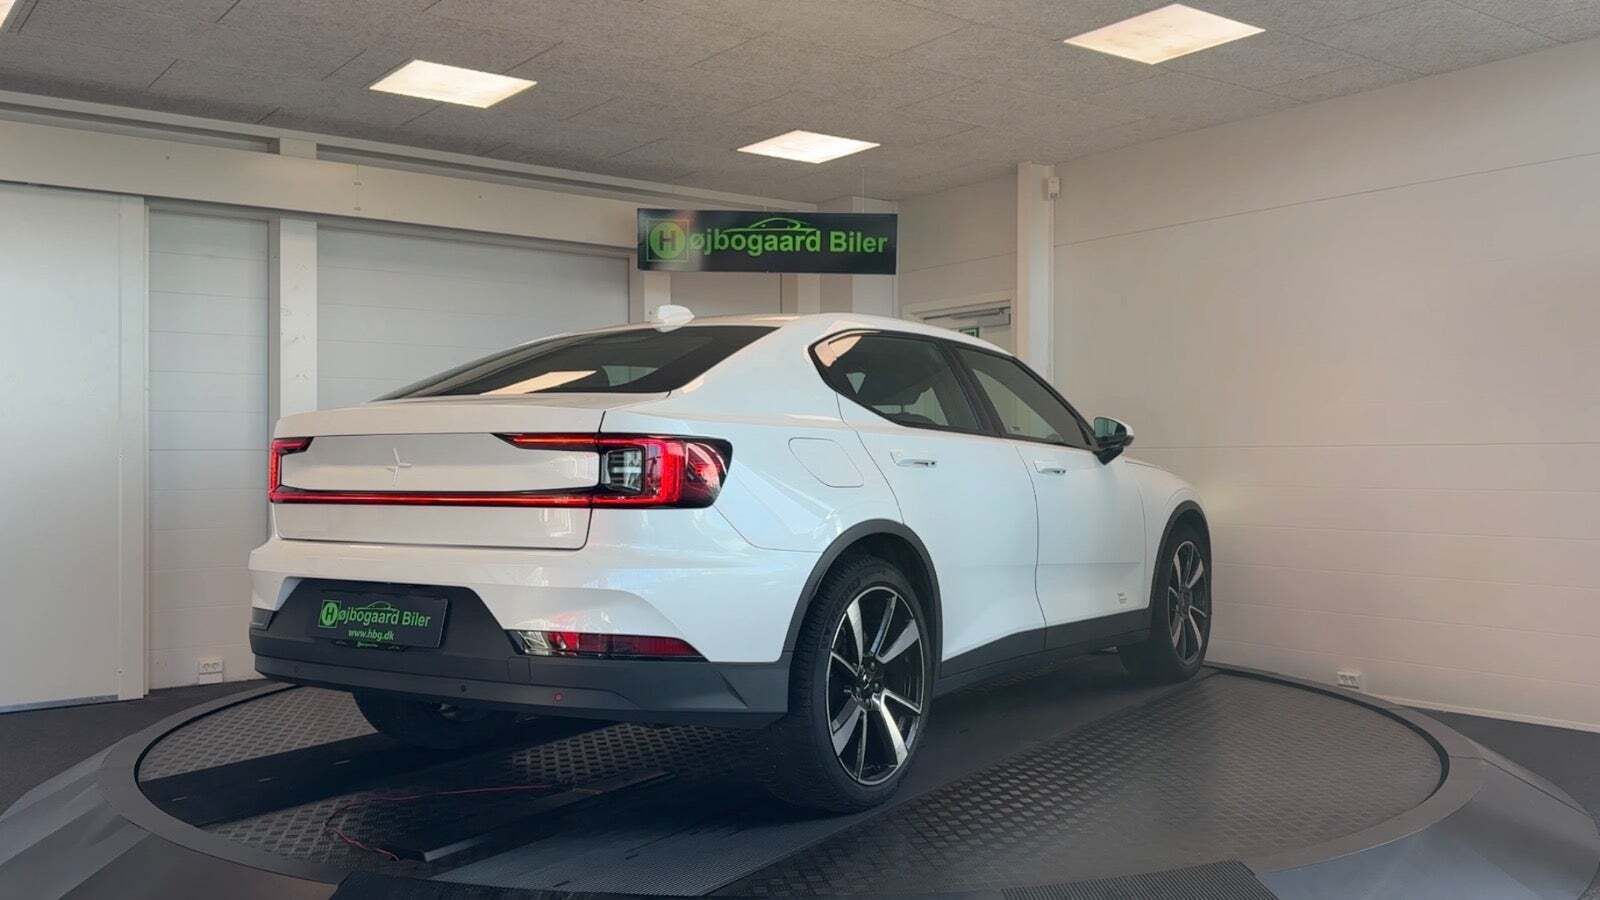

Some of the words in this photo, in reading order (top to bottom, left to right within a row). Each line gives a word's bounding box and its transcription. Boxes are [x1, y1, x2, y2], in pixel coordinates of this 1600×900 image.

[651, 223, 821, 258] Højbogaard
[829, 230, 888, 253] Biler
[322, 603, 400, 626] Højbogaard
[402, 611, 431, 627] Biler
[347, 628, 395, 642] www.hbg.dk
